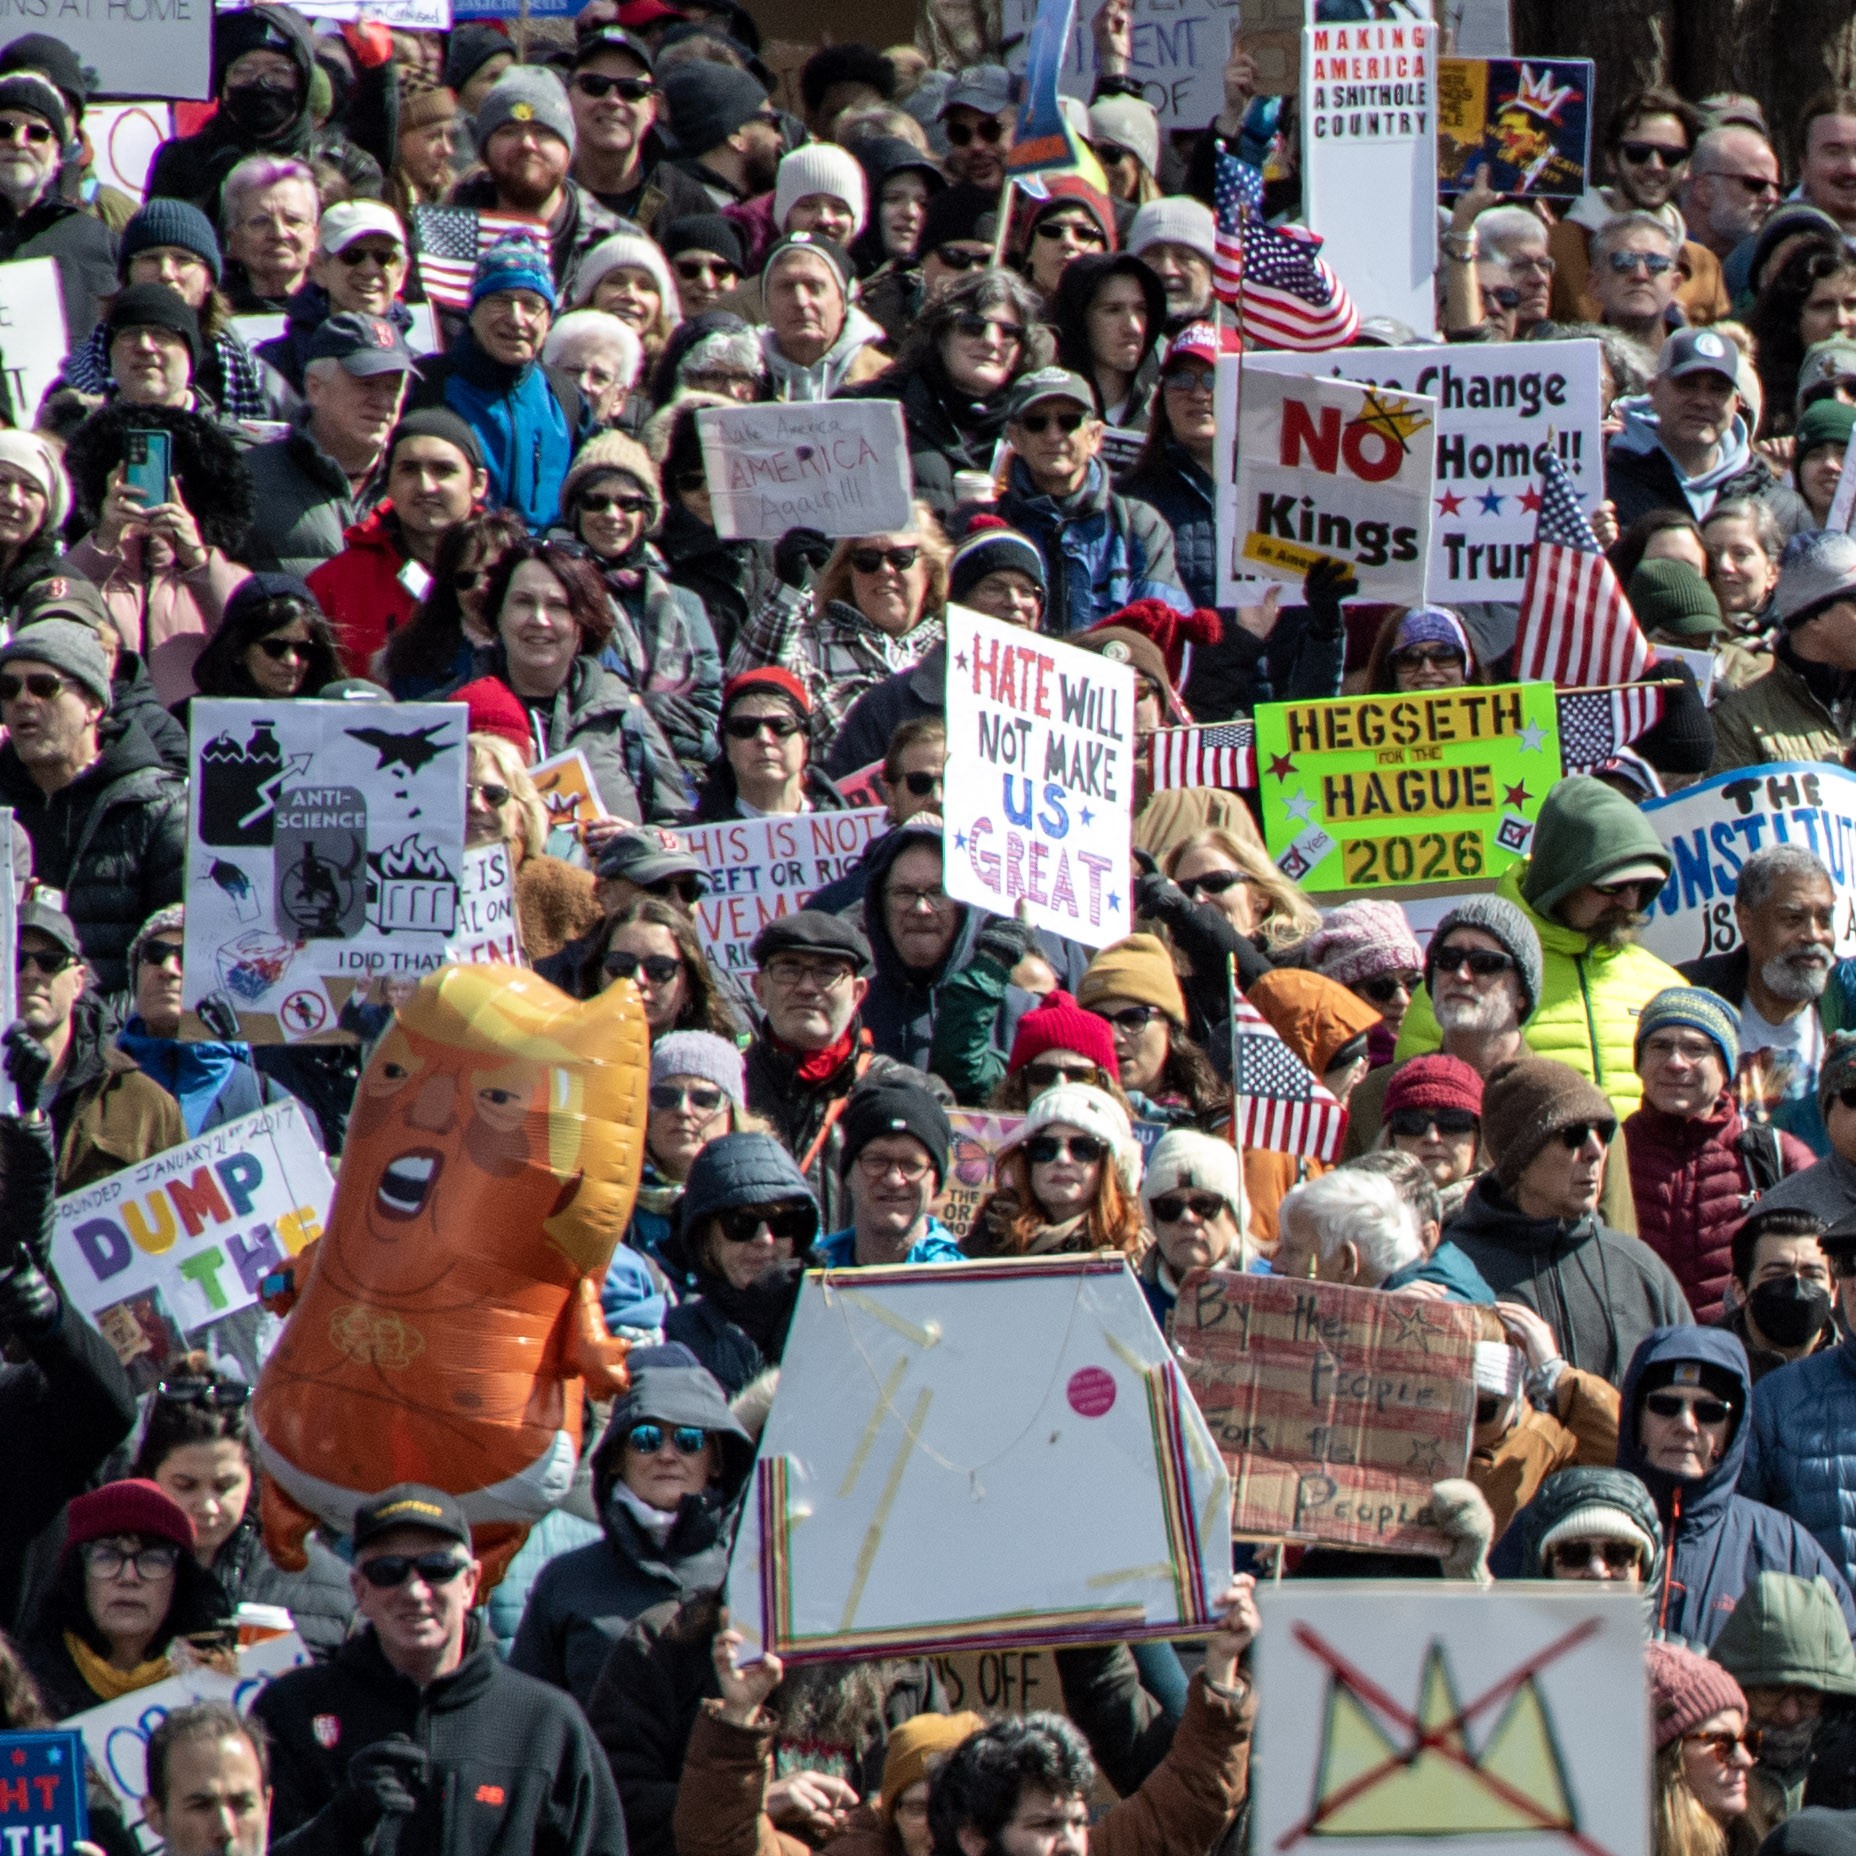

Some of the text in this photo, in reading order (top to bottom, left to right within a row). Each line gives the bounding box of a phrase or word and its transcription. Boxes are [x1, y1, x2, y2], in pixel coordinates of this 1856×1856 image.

[1314, 25, 1427, 52] MAKING
[1313, 55, 1427, 80] AMERICA
[1314, 82, 1427, 108] A SHITHOLE
[1314, 110, 1427, 138] COUNTRY
[1416, 366, 1566, 419] Change
[1279, 397, 1404, 482] NO
[1256, 492, 1419, 567] Kings
[970, 630, 1124, 742] HATE WILL
[1285, 688, 1526, 753] HEGSETH
[977, 710, 1121, 803] NOT MAKE
[290, 790, 352, 808] ANTI-
[1002, 772, 1070, 840] US
[1322, 766, 1495, 821] HAGUE
[1722, 772, 1823, 816] THE
[275, 811, 366, 832] SCIENCE
[766, 813, 879, 860] IS NOT
[770, 861, 805, 887] OR
[967, 815, 1114, 929] GREAT
[1345, 830, 1486, 887] 2026
[350, 951, 446, 972] DID THAT
[136, 1104, 296, 1184] JANUARY 2017
[72, 1151, 263, 1282] DUMP
[949, 1188, 980, 1204] THE
[1195, 1278, 1251, 1351] By
